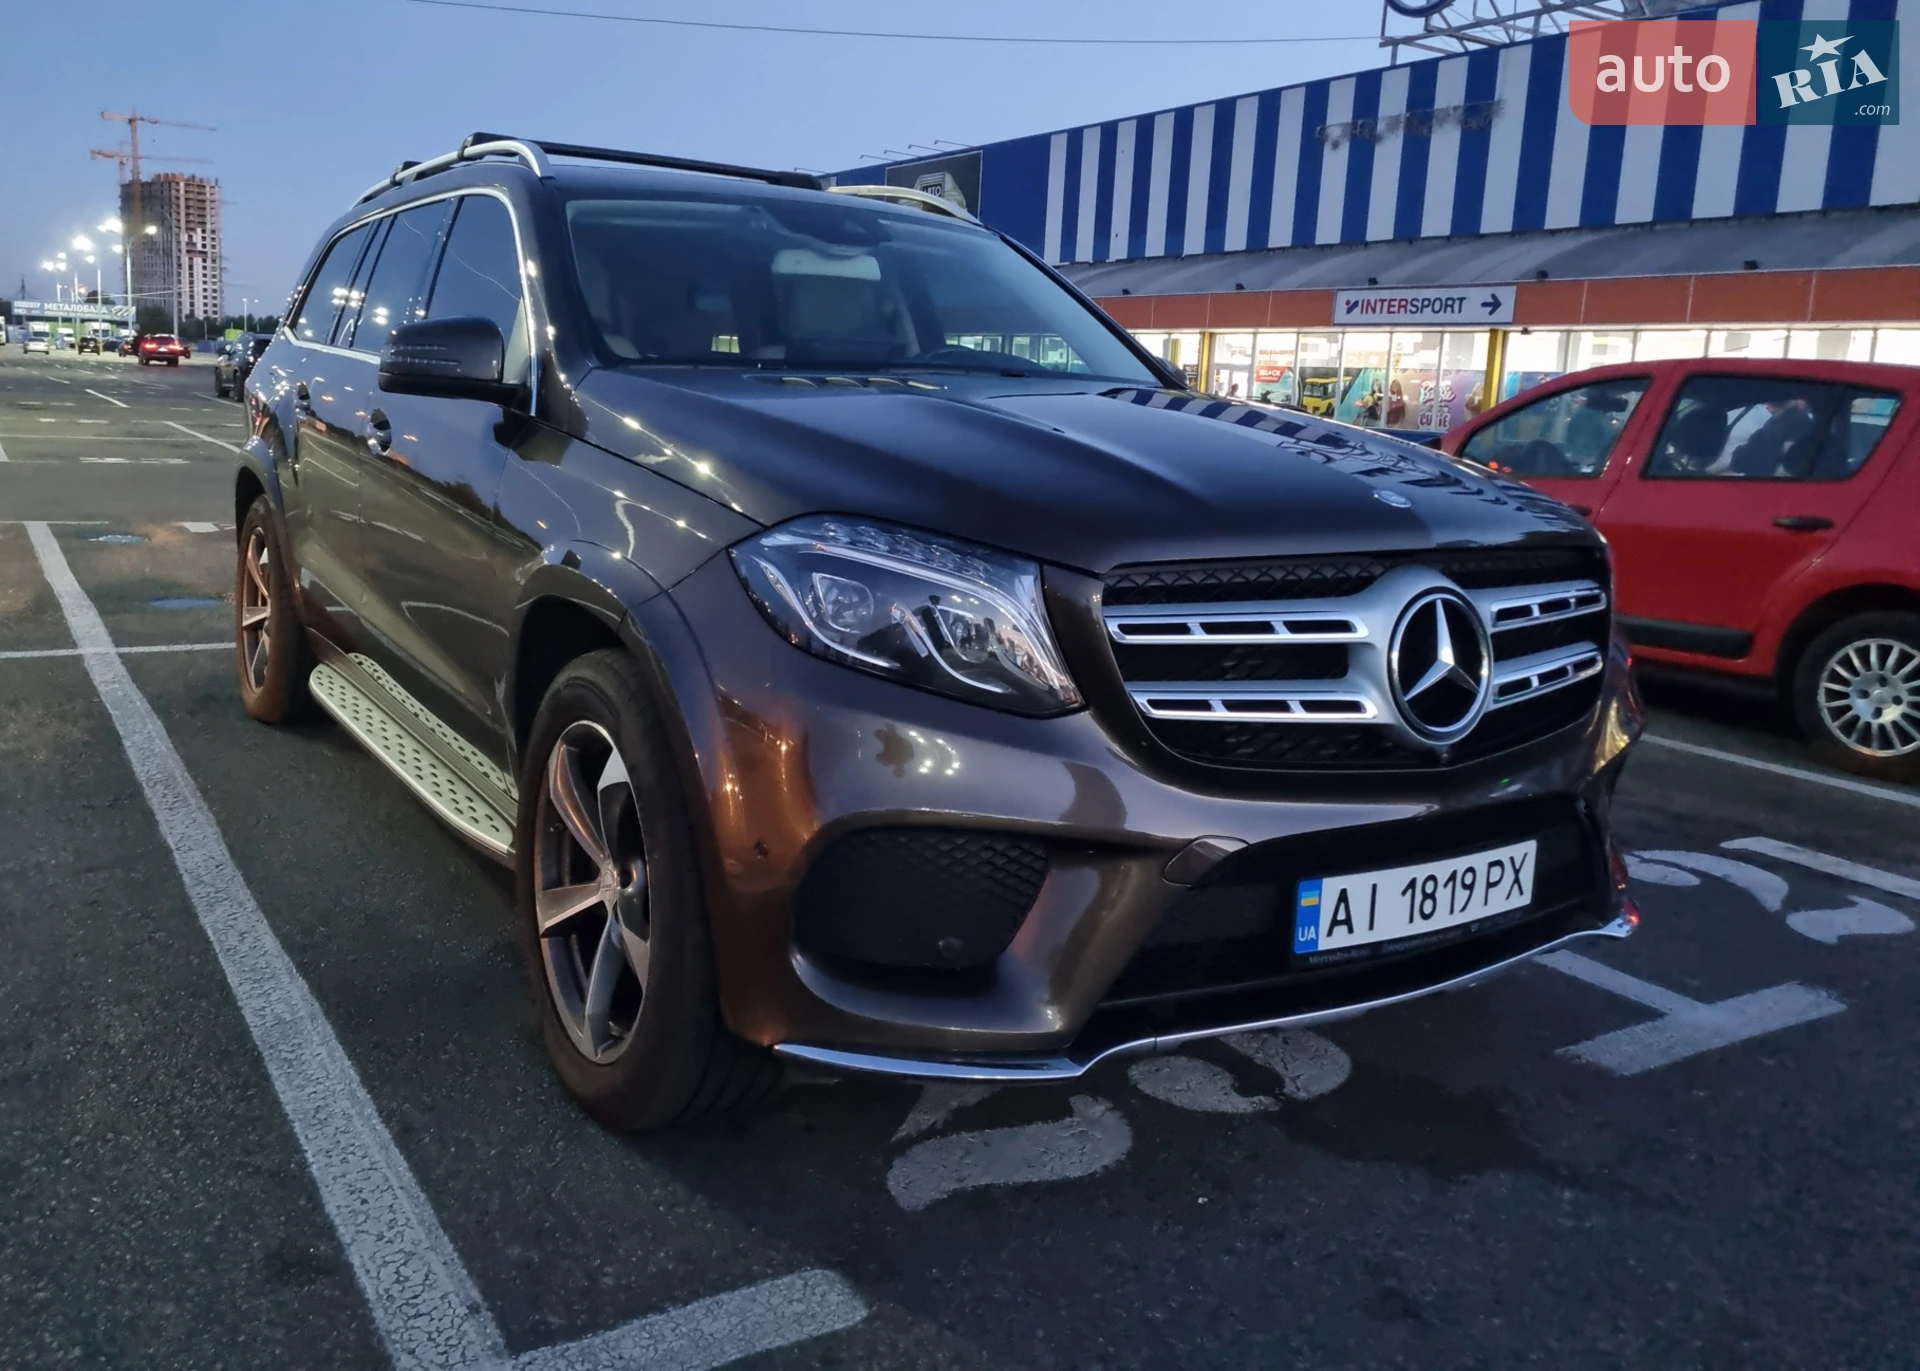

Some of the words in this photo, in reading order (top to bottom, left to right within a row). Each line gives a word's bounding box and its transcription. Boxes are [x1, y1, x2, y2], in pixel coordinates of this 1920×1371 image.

[1360, 297, 1467, 315] INTERSPORT
[1326, 883, 1378, 938] AI
[1401, 866, 1477, 924] 1819
[1483, 852, 1529, 907] PX
[1298, 925, 1317, 942] UA
